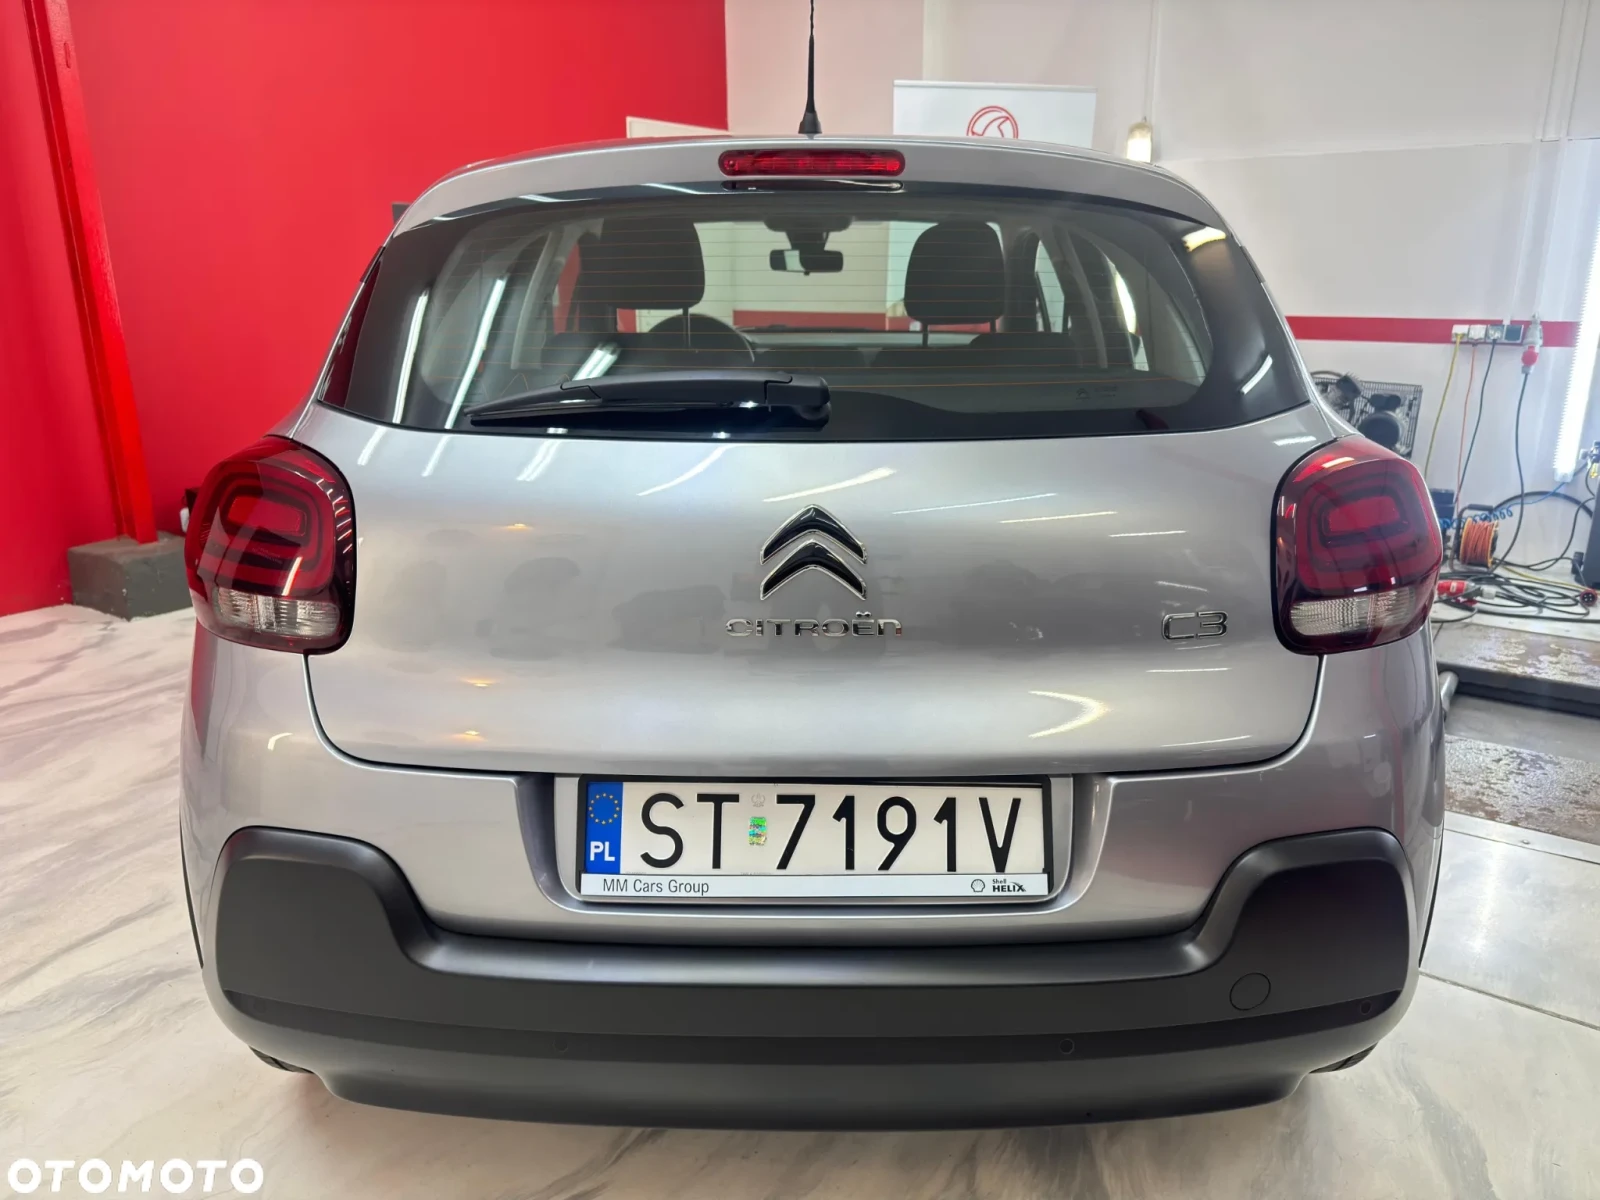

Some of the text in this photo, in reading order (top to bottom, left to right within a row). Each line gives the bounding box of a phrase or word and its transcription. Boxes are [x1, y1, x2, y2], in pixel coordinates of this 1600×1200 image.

[1162, 611, 1228, 640] C3
[640, 792, 1022, 873] ST 7191V
[589, 841, 616, 862] PL
[603, 878, 709, 896] MM Cars Group
[992, 884, 1026, 893] HELIX
